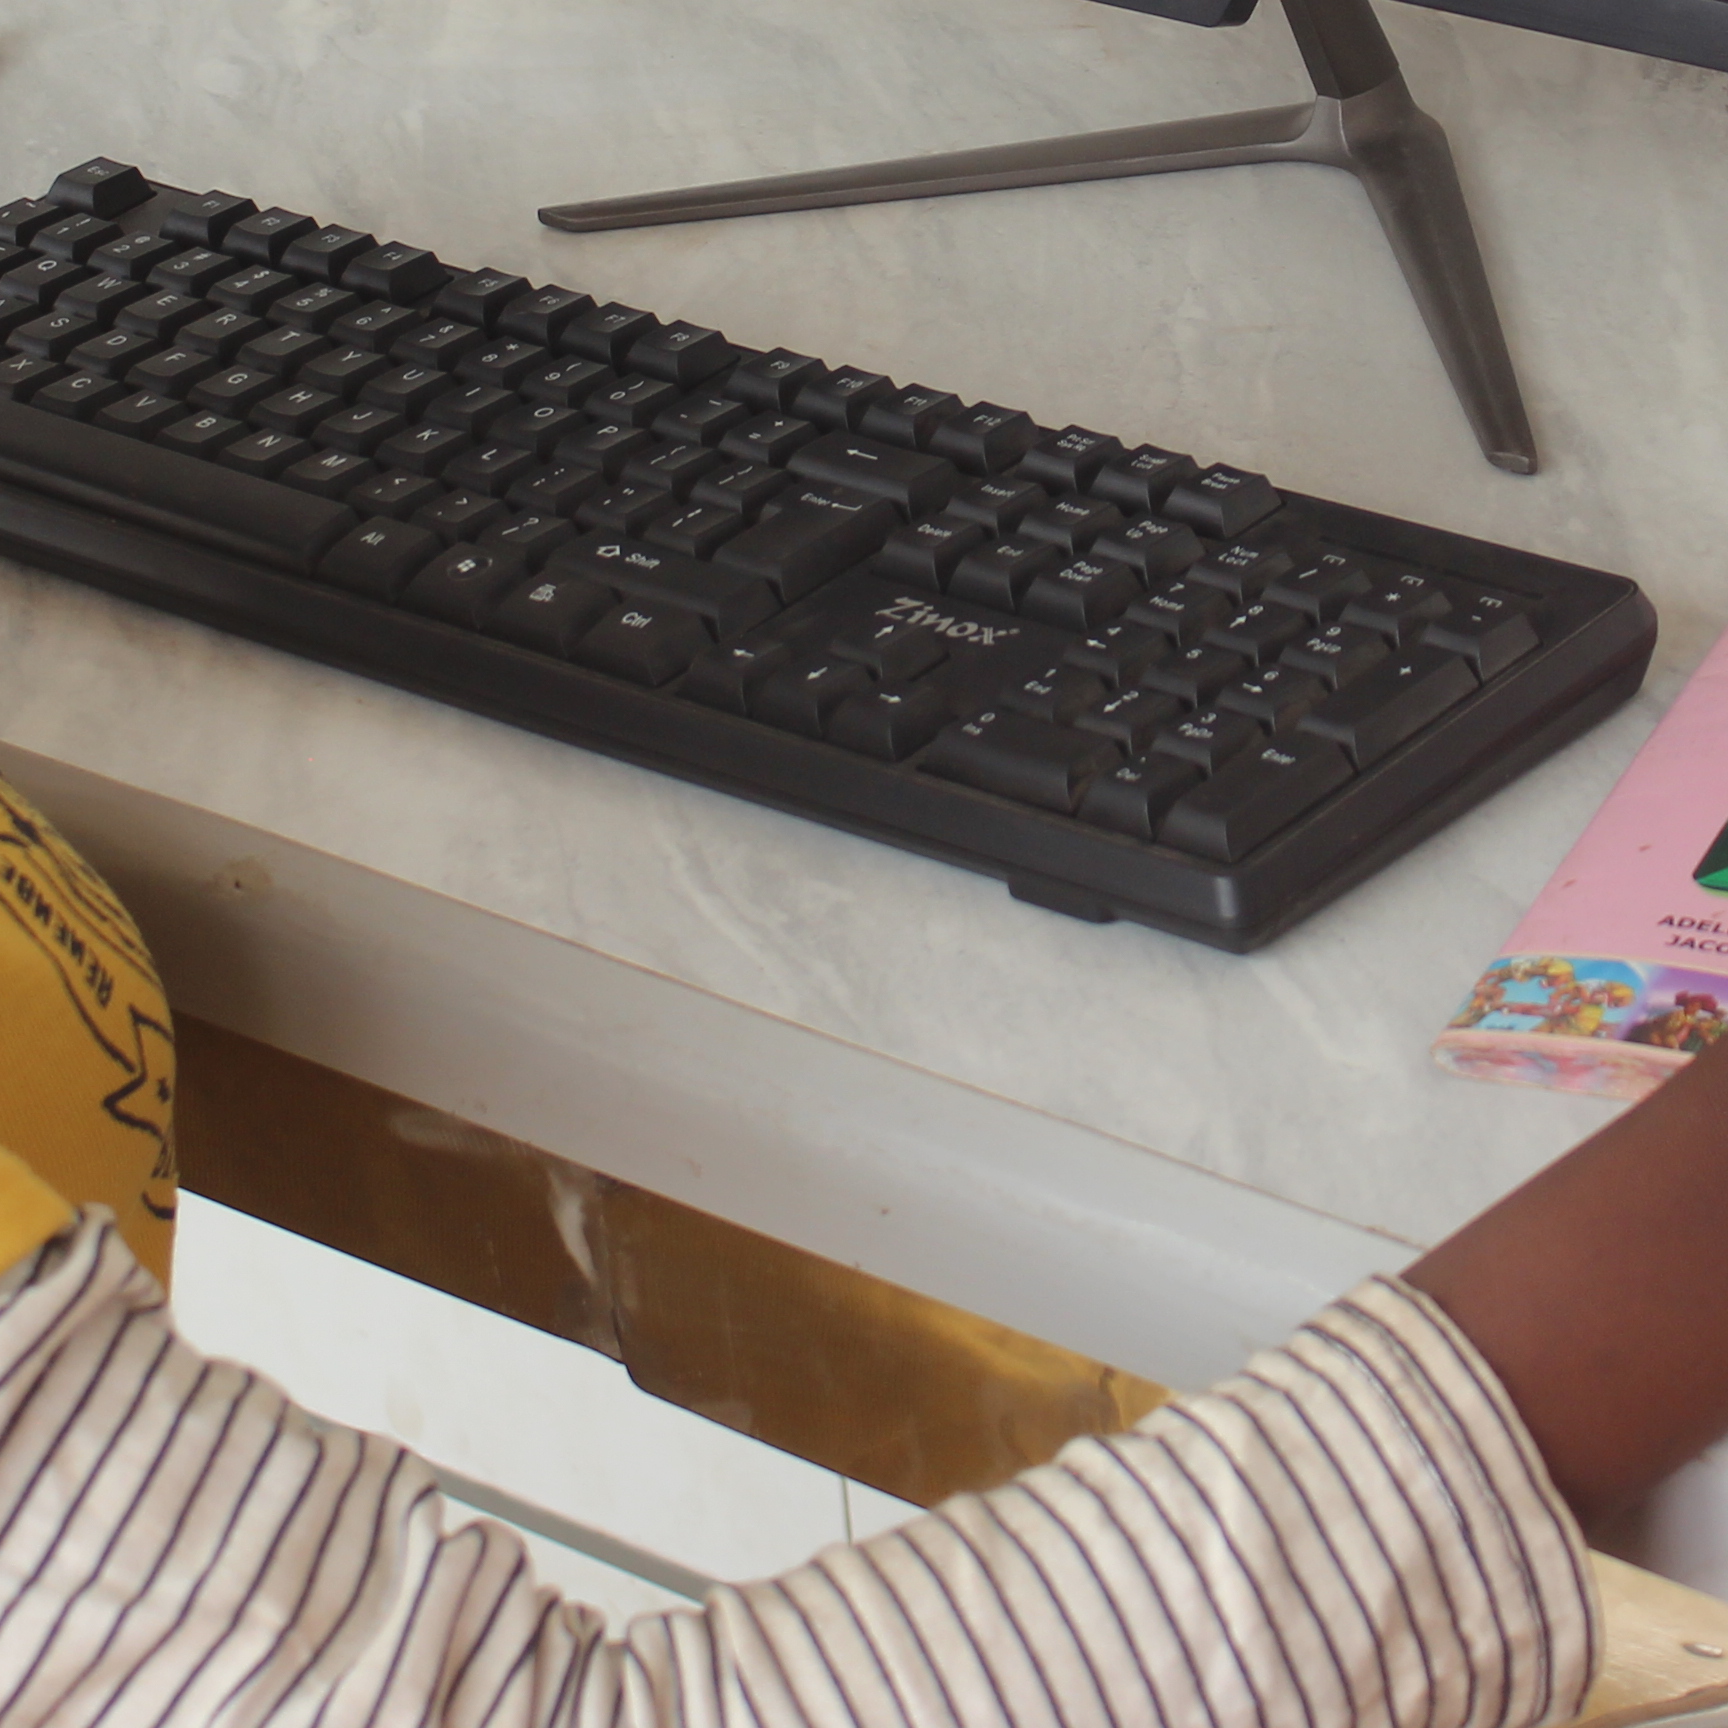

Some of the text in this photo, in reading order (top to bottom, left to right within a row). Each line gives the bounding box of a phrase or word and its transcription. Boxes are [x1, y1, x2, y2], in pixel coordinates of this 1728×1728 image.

[87, 165, 110, 177] Esc
[37, 259, 57, 272] Q
[97, 276, 122, 290] W
[157, 294, 179, 307] E
[50, 317, 70, 328] S
[216, 312, 237, 326] R
[106, 334, 127, 346] D
[280, 329, 300, 342] T
[164, 351, 187, 363] F
[341, 350, 362, 362] Y
[9, 358, 33, 371] X
[227, 372, 248, 384] G
[402, 368, 424, 381] U
[71, 377, 92, 389] C
[836, 377, 865, 389] F10
[288, 390, 313, 403] H
[465, 386, 481, 397] I
[135, 395, 157, 408] V
[904, 395, 928, 407] F11
[352, 410, 373, 421] J
[533, 406, 555, 418] O
[195, 416, 216, 428] B
[973, 414, 1003, 426] F12
[416, 428, 439, 441] K
[596, 425, 619, 435] P
[256, 434, 282, 448] N
[321, 453, 348, 468] M
[481, 448, 497, 461] L
[981, 483, 1016, 498] Insert
[800, 492, 832, 506] Enter
[1055, 501, 1090, 516] Home
[917, 523, 952, 538] Delete
[1138, 519, 1168, 534] Page
[360, 531, 385, 546] Alt
[1125, 528, 1144, 539] Up
[996, 545, 1024, 557] End
[1229, 545, 1260, 559] Num
[625, 553, 661, 569] Shift
[1217, 553, 1249, 566] Lock
[1073, 560, 1103, 575] Page
[1059, 568, 1092, 582] Down
[1169, 582, 1185, 592] 7
[1149, 596, 1185, 611] Home
[622, 611, 653, 629] Ctrl
[875, 597, 1012, 645] Zinox
[1024, 680, 1052, 695] End
[1261, 748, 1297, 765] Enter
